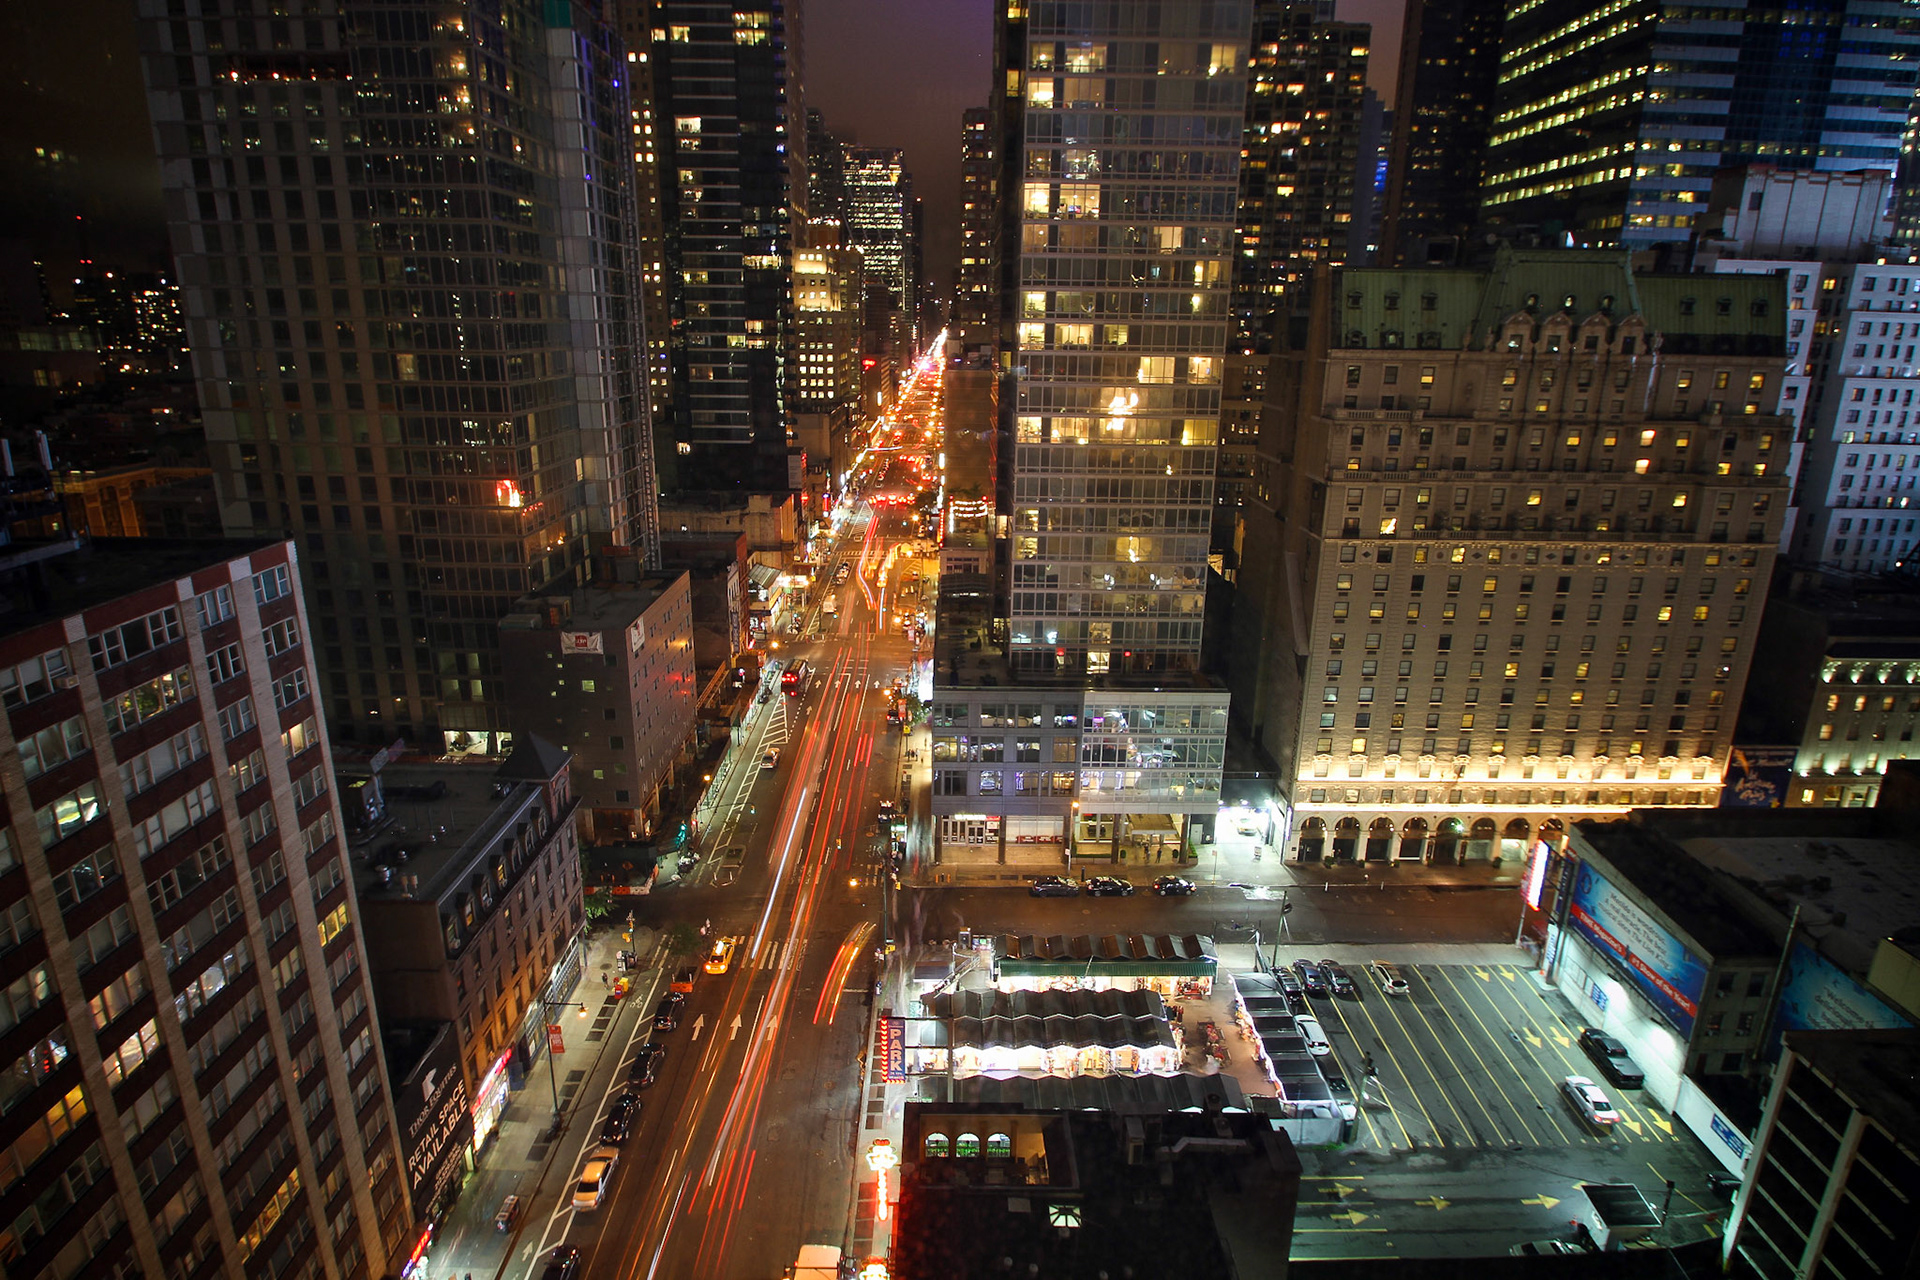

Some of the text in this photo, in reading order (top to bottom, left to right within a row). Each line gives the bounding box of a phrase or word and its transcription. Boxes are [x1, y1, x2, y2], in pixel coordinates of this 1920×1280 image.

[890, 1028, 902, 1071] PARK
[408, 1103, 431, 1136] THOR
[429, 1063, 457, 1107] EQUITIES
[408, 1126, 439, 1172] RETAIL
[438, 1079, 465, 1123] SPACE
[412, 1096, 468, 1190] AVAILABLE
